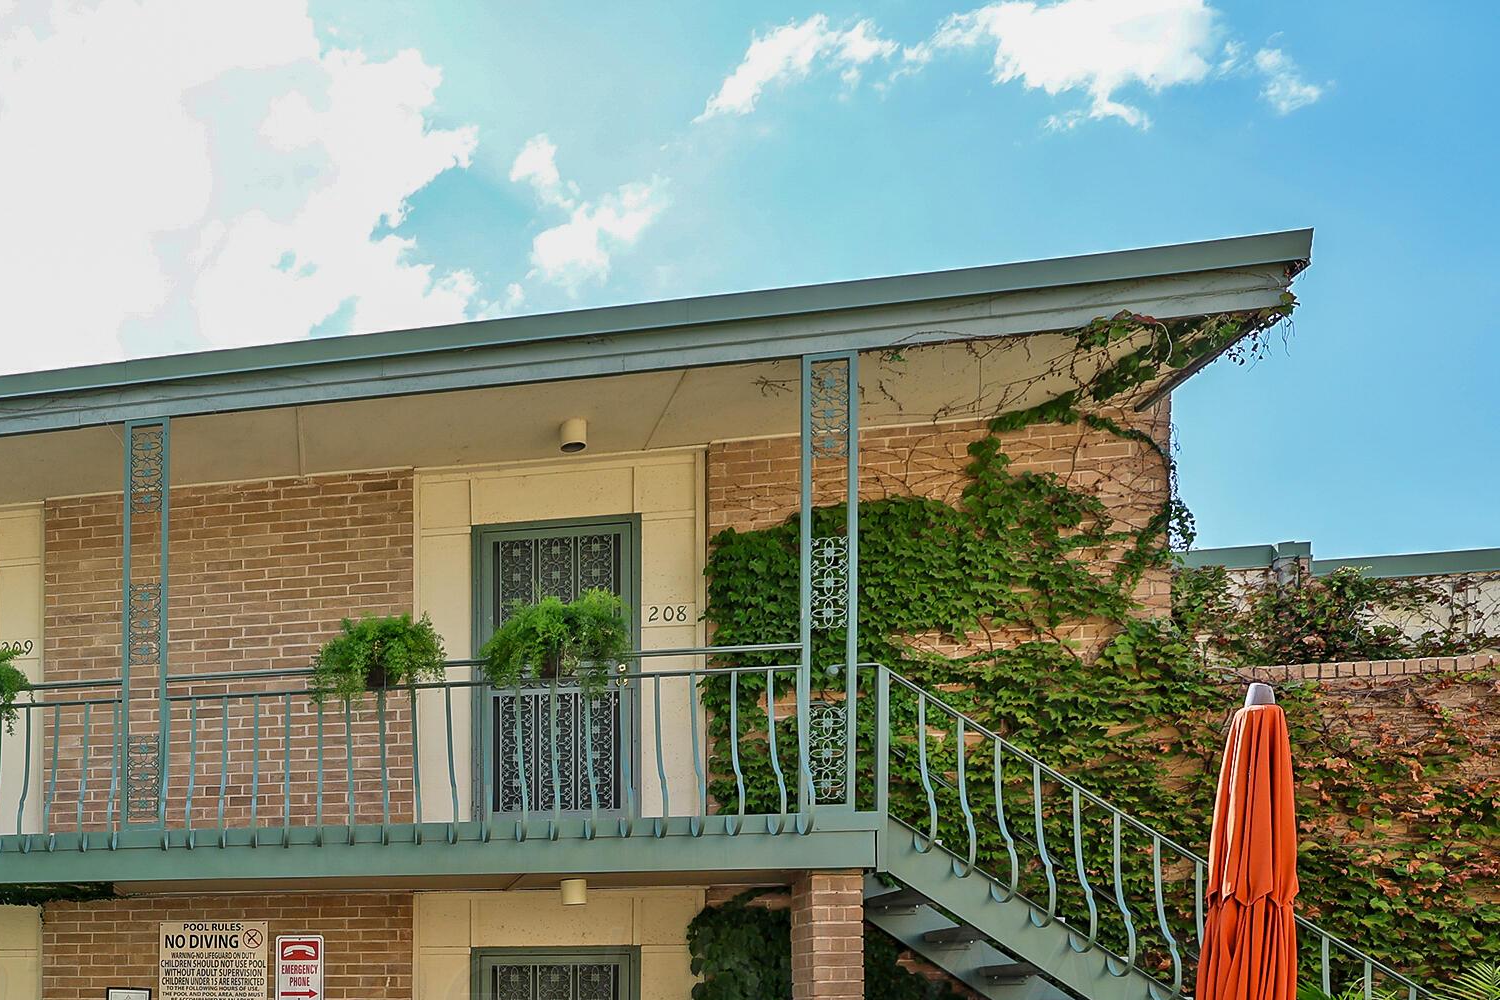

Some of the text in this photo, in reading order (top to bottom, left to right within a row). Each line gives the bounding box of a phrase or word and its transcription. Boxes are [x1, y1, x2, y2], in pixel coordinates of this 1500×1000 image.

[648, 605, 687, 622] 208
[1, 639, 33, 655] 209
[183, 923, 244, 931] POOL RULES:
[164, 934, 239, 949] NO DIVING
[205, 951, 232, 959] LIFEGUARD
[232, 951, 241, 959] ON
[241, 951, 256, 959] DUTY
[160, 960, 266, 968] CHILDREN SHOULD NOT USE POOL
[164, 968, 262, 977] WITHOUT ADULT SUPERVISION
[281, 964, 318, 975] EMERGENCY
[161, 977, 264, 986] CHILDREN UNDER 15 ARE RESTRICTED
[289, 976, 310, 986] PHONE
